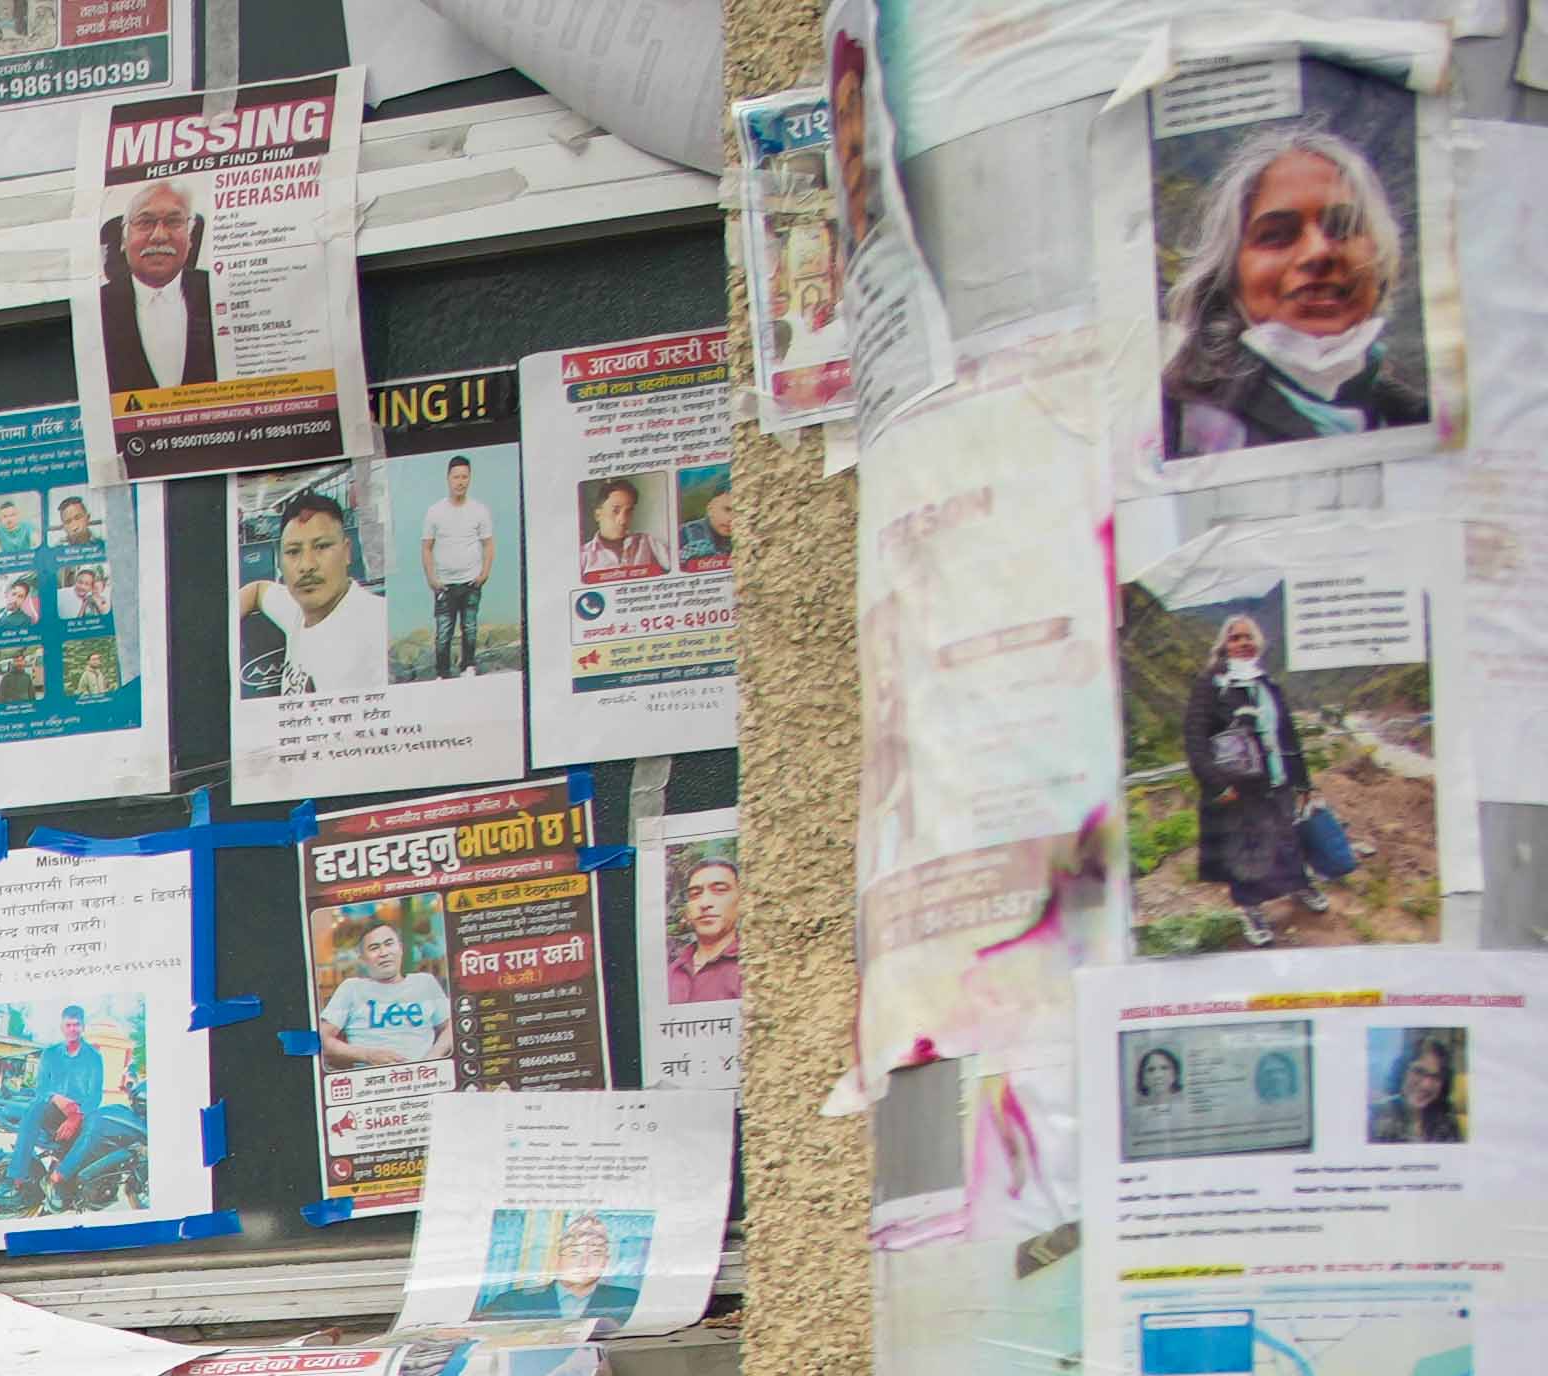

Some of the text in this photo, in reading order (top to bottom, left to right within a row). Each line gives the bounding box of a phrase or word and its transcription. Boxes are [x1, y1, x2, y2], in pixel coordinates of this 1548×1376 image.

[111, 101, 327, 167] MISSING
[146, 147, 293, 178] HELP US FIND HIM
[214, 161, 321, 189] SIVAGNANAM
[368, 999, 424, 1029] Lee
[365, 1114, 409, 1131] SHARE
